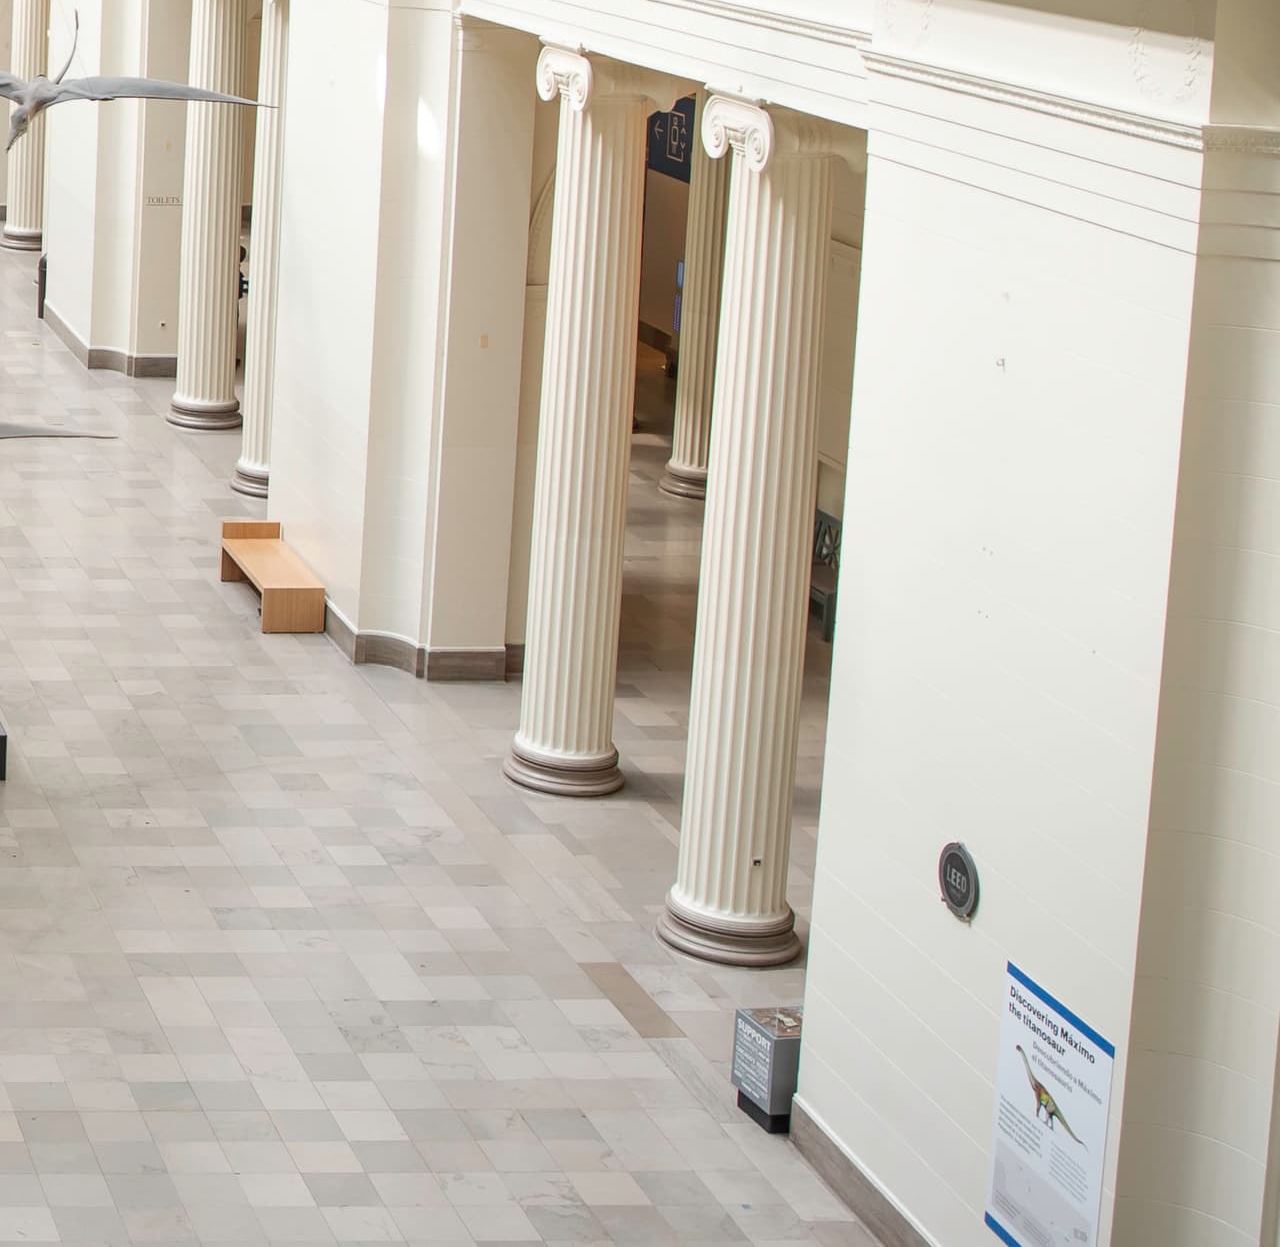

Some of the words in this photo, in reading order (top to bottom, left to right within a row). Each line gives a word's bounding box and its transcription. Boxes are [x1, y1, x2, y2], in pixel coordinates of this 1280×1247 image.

[147, 196, 181, 204] TOILETS
[946, 864, 967, 894] LEED
[737, 1017, 772, 1051] SUPPORT
[1008, 1002, 1022, 1020] the
[1023, 1013, 1066, 1056] titanosaur
[1009, 985, 1059, 1036] Discovering
[1060, 1026, 1096, 1064] Máximo
